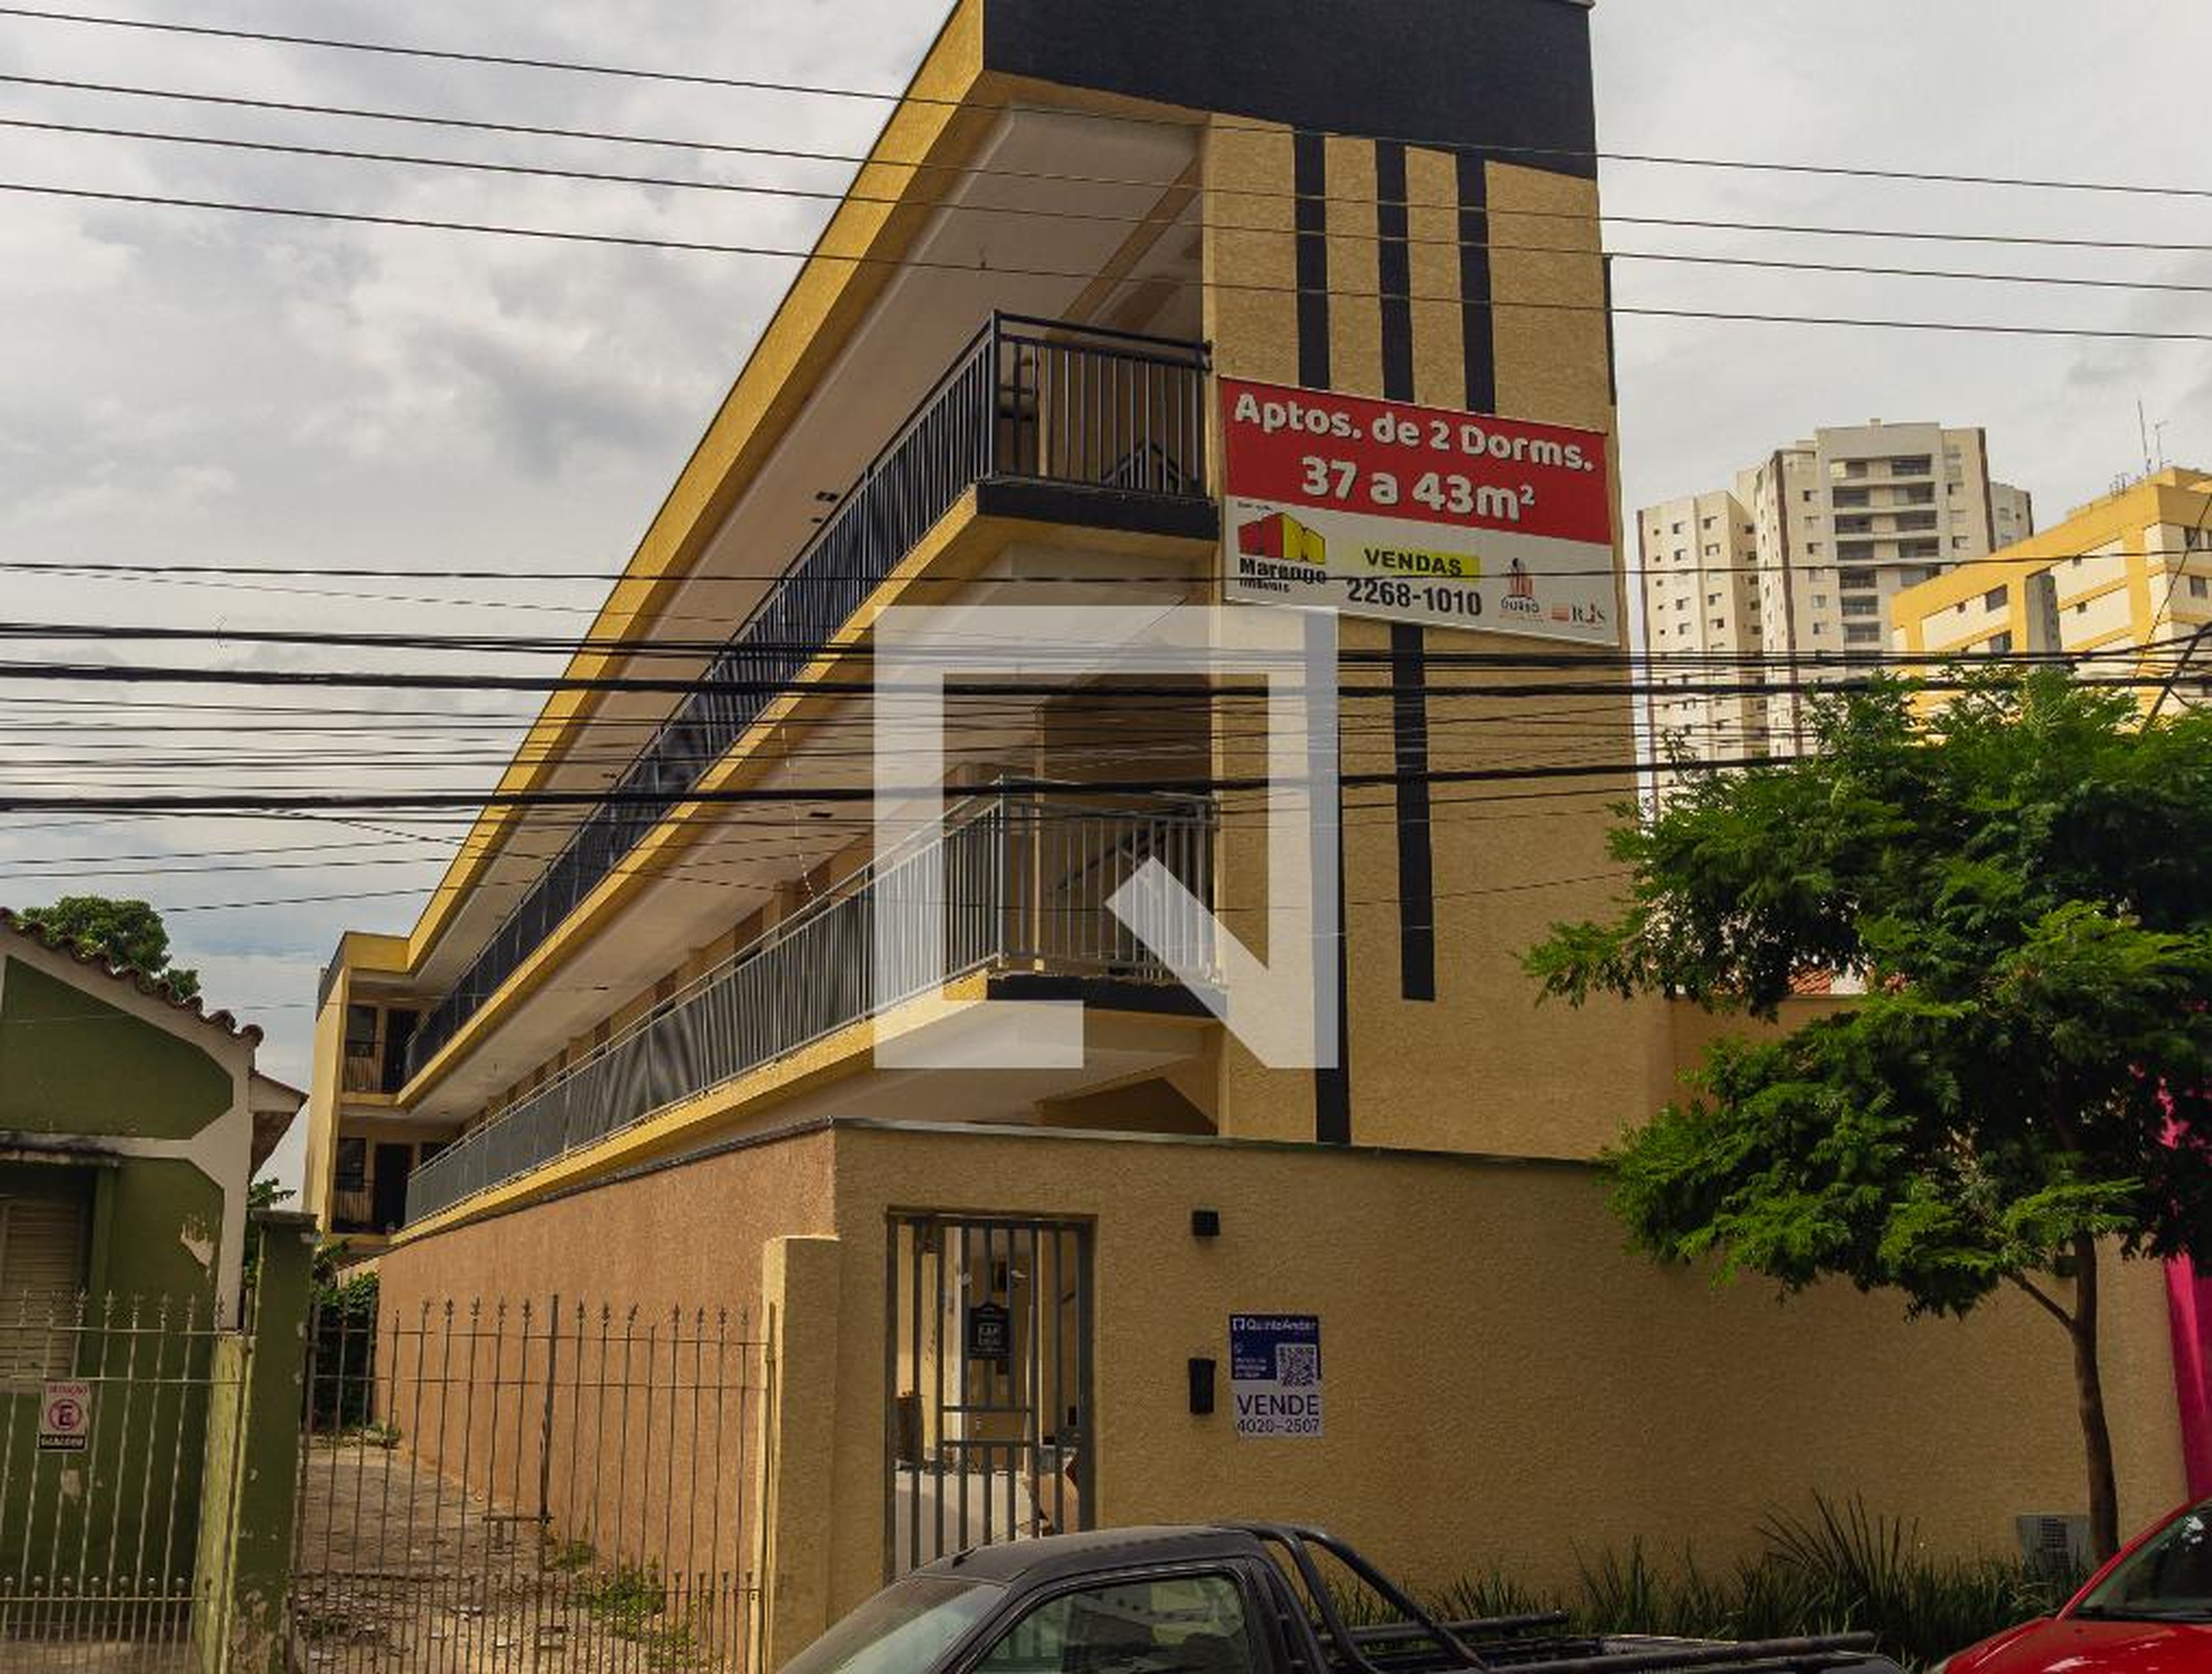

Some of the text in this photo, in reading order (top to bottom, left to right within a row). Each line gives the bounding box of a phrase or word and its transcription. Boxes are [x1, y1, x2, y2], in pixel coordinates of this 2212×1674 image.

[1235, 393, 1594, 472] Aptos. de 2 Dorms.
[1301, 455, 1357, 500] 37
[1370, 472, 1398, 505] a
[1239, 557, 1326, 585] Marengo
[1363, 548, 1463, 576] VENDAS
[1346, 577, 1483, 616] 2268-1010
[1237, 1394, 1319, 1415] VENDE
[1238, 1418, 1319, 1433] 4020-2507
